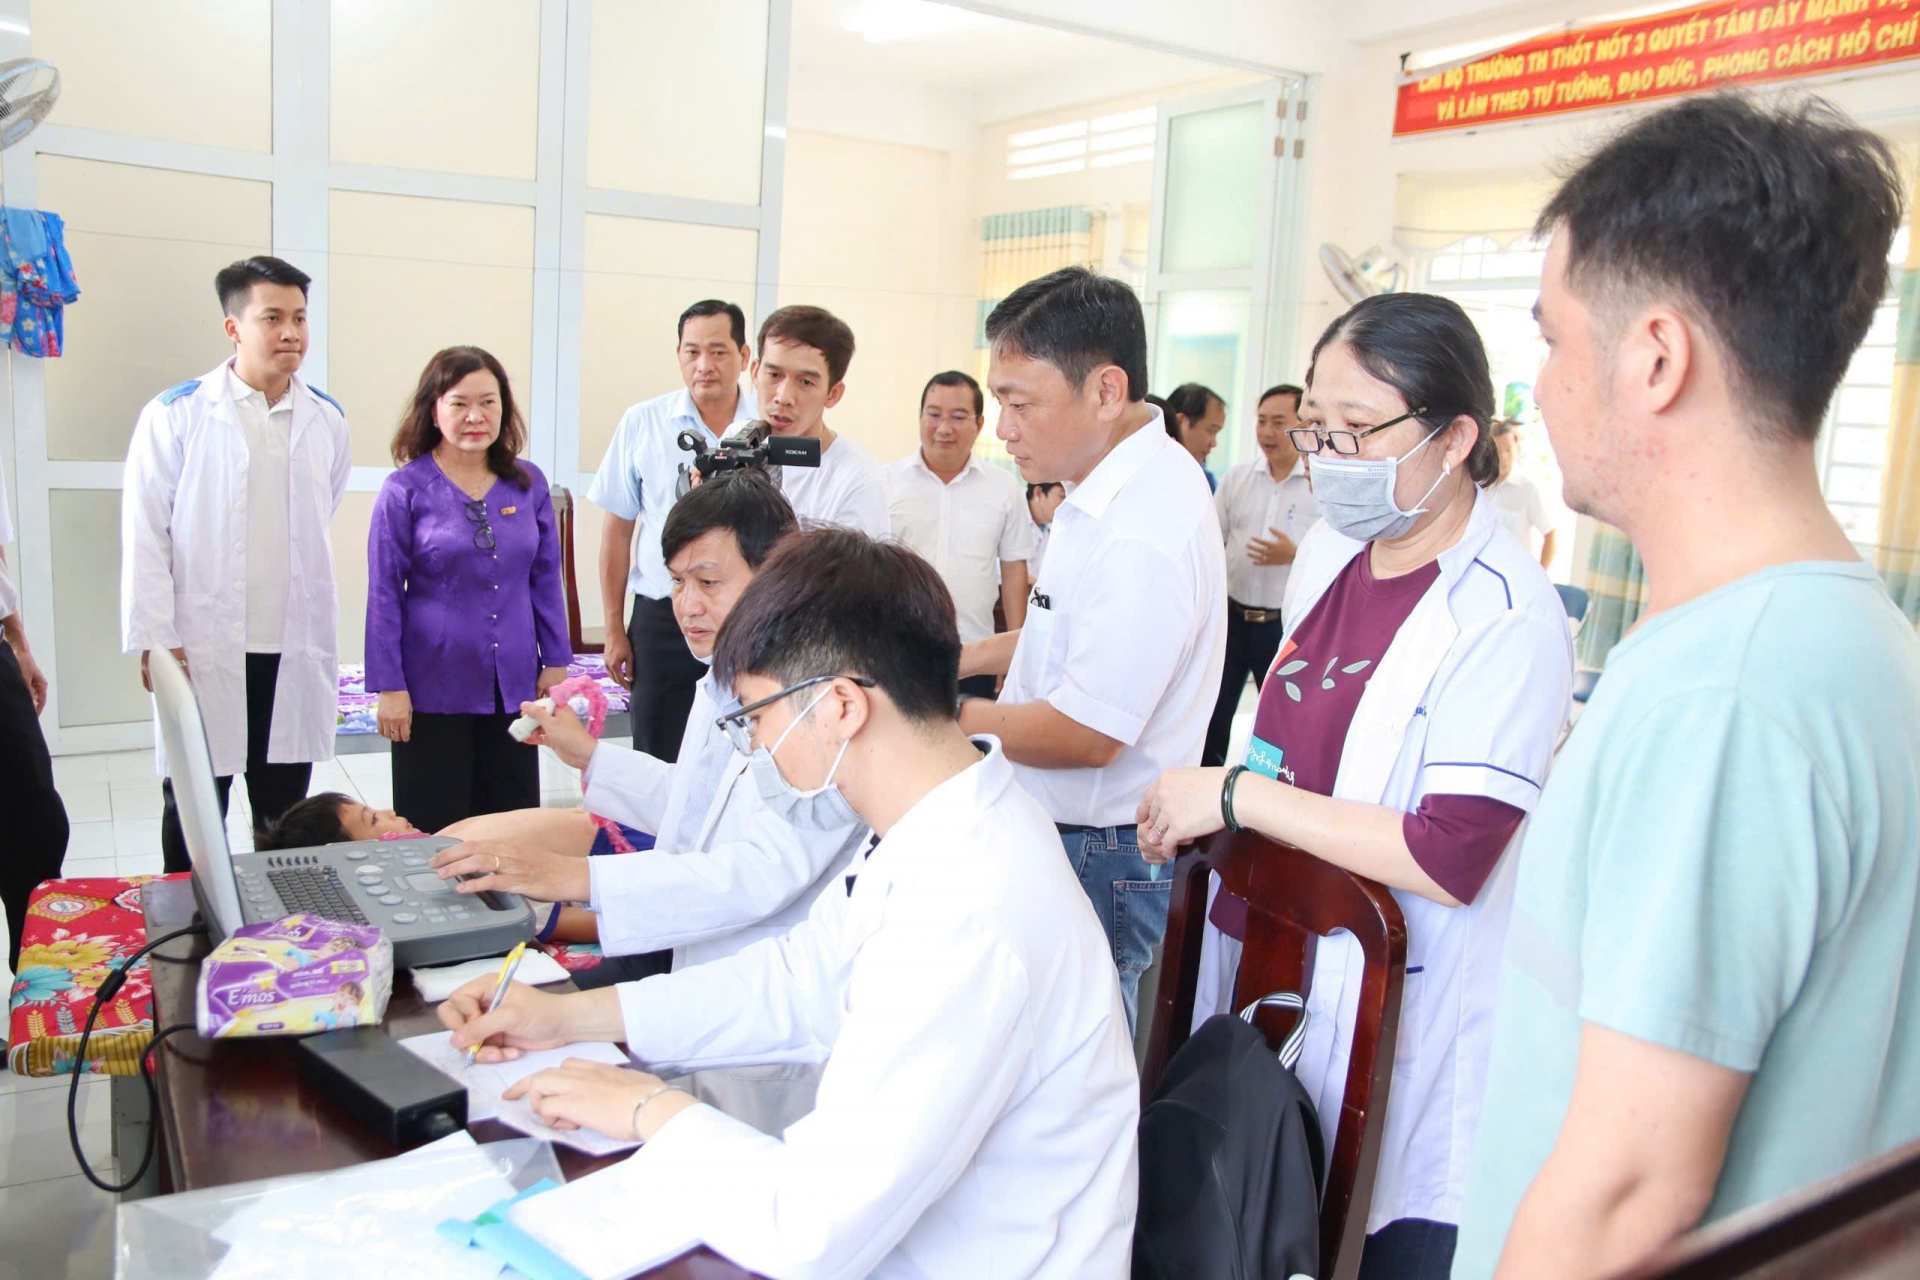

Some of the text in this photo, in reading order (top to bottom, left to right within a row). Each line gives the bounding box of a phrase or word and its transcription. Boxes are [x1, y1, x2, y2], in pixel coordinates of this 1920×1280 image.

[1437, 12, 1920, 121] VÀ LÀM THEO TƯ TƯỞNG, ĐẠO ĐỨC, PHONG CÁCH HỒ CHÍ
[1467, 54, 1525, 84] TRƯỜNG
[1528, 49, 1549, 74] TH
[1551, 34, 1594, 69] THỐT
[1595, 28, 1632, 62] NỐT
[1633, 32, 1646, 54] 3
[1649, 13, 1710, 53] QUYẾT
[1713, 8, 1756, 40] TÂM
